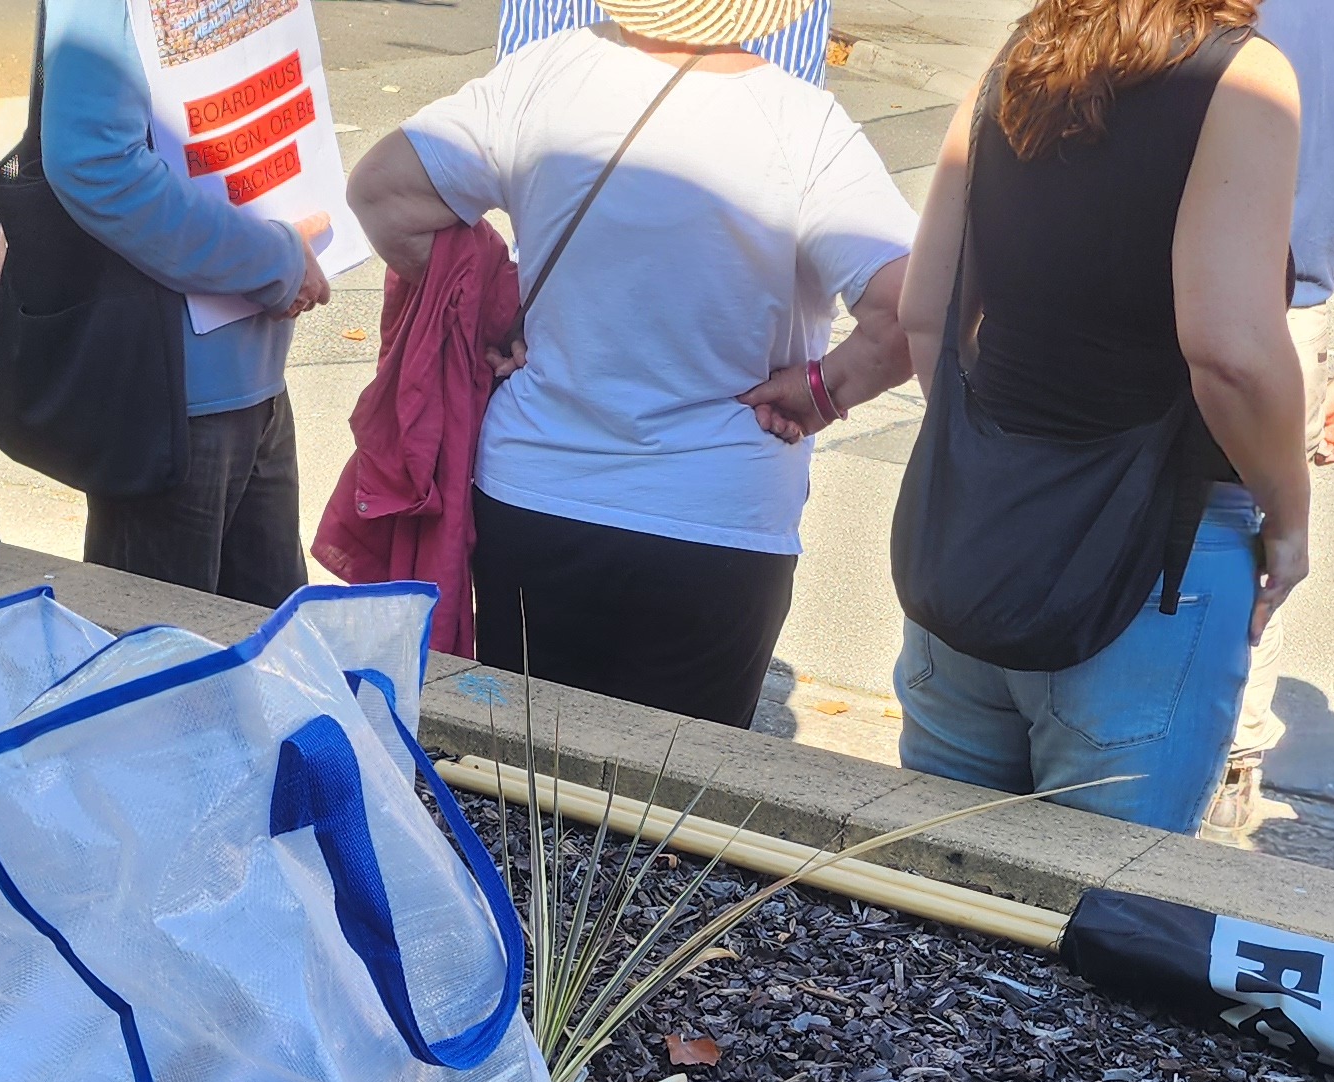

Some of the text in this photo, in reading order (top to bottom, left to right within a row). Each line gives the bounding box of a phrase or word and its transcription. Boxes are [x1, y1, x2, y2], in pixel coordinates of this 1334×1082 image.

[188, 57, 302, 128] BOARD MUST
[187, 92, 314, 171] RESIGN, OR BE
